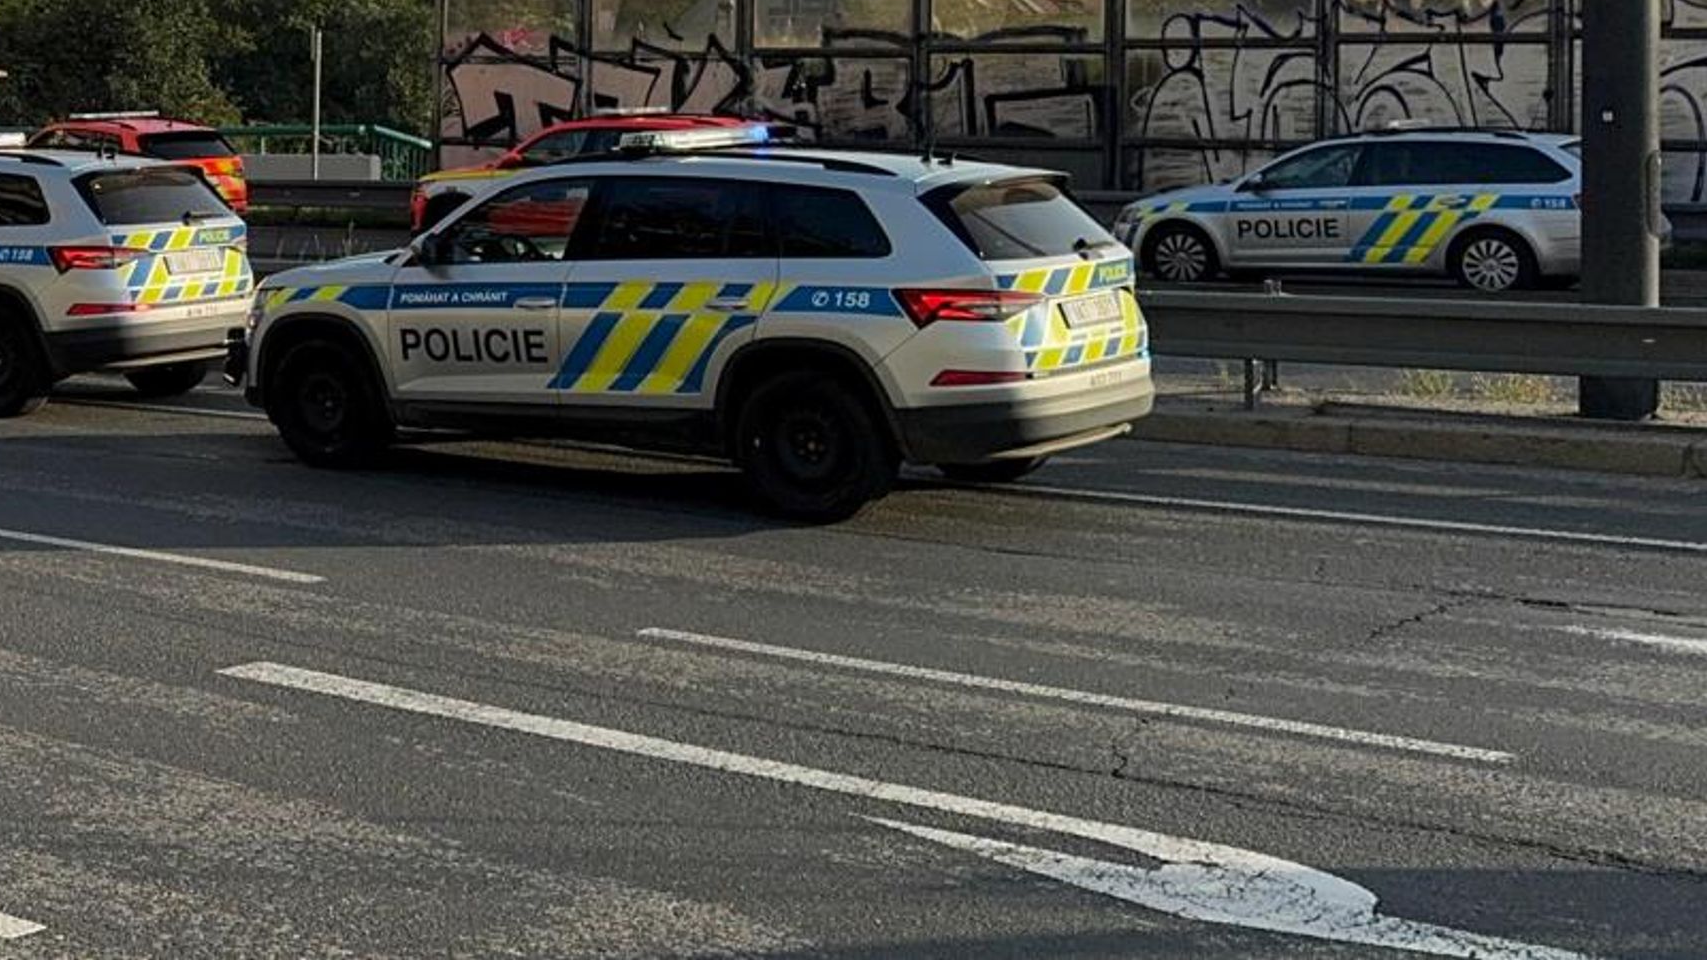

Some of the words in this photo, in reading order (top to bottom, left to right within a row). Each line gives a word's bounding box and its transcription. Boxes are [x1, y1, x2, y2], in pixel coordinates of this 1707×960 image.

[1237, 218, 1339, 239] POLICIE
[11, 249, 34, 261] 158
[451, 293, 459, 303] A
[835, 291, 870, 308] 158
[400, 327, 548, 363] POLICIE
